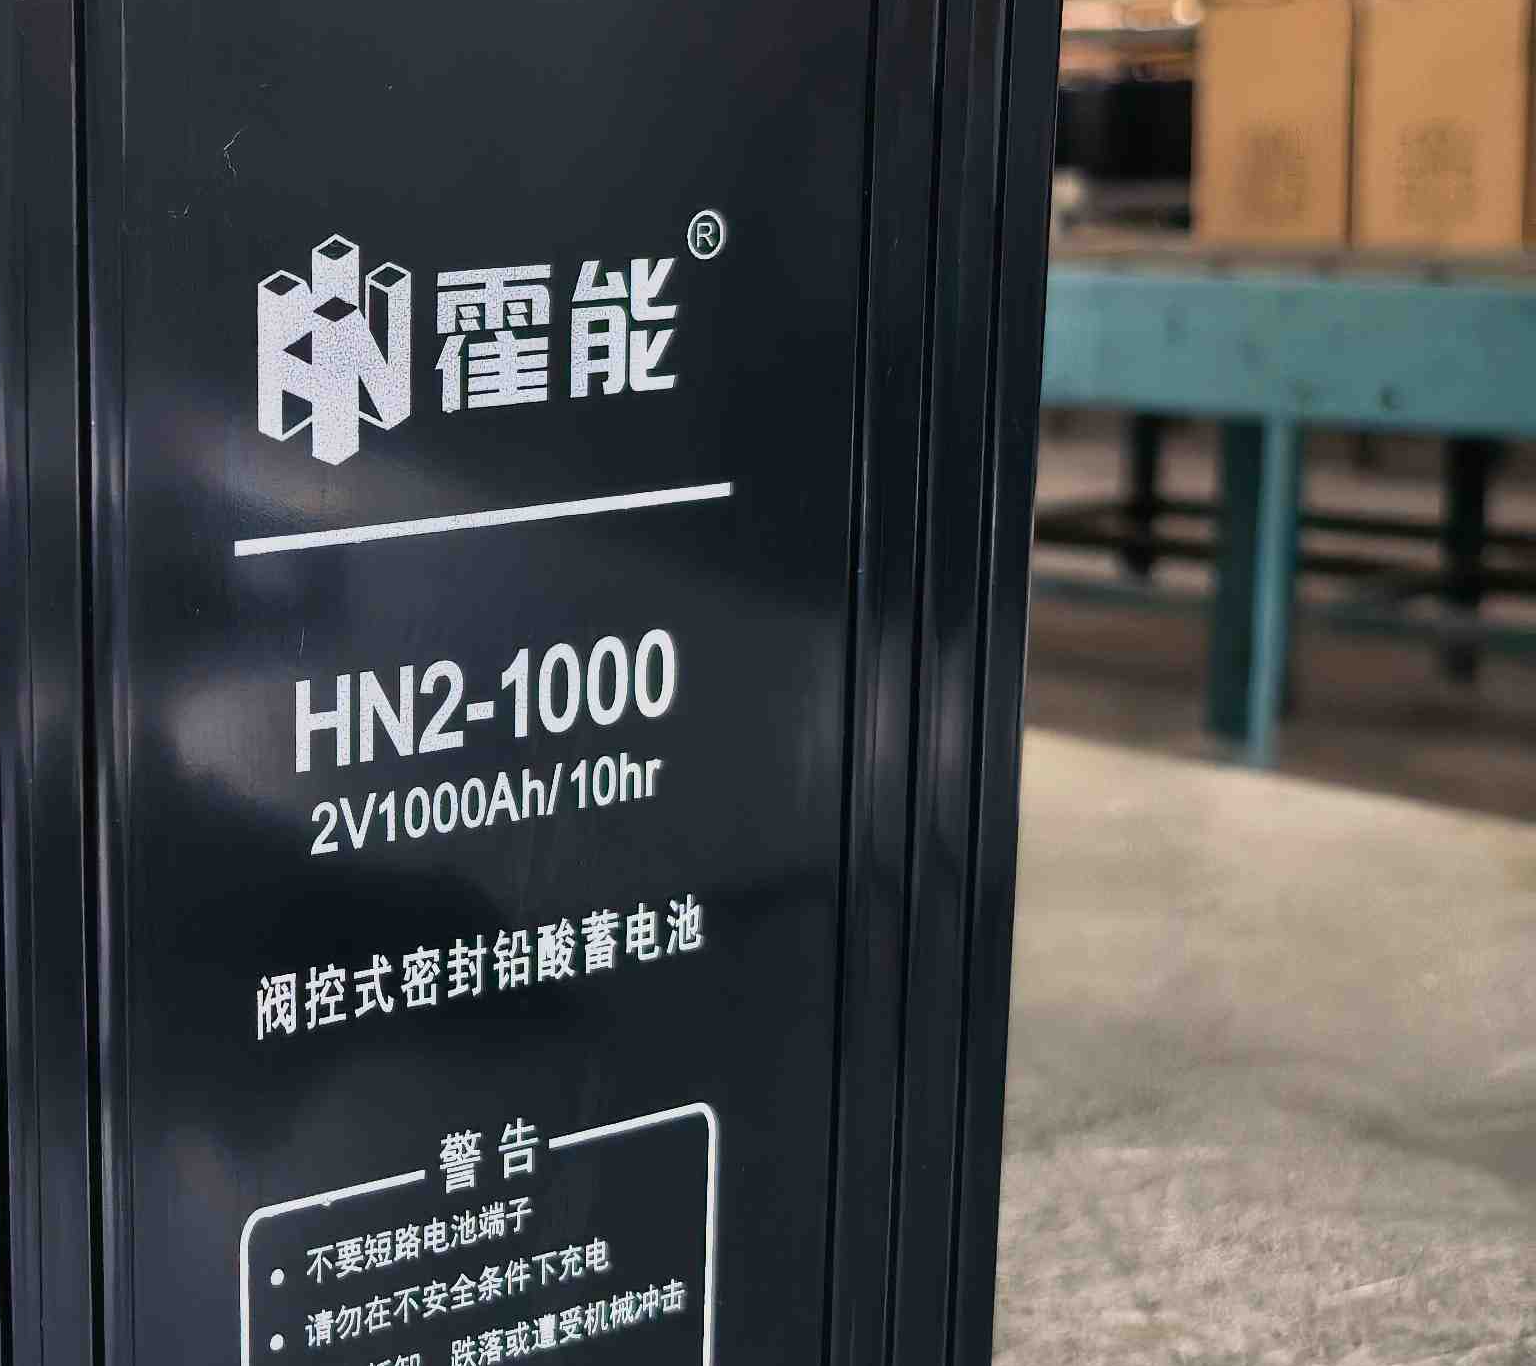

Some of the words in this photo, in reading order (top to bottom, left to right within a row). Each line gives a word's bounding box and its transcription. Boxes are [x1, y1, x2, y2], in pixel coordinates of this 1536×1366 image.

[436, 257, 678, 413] 霍能
[295, 629, 677, 773] HN2-1000
[311, 752, 662, 856] 2V1000Ah/10hr
[257, 893, 704, 1041] 阀控式密封铅酸蓄电池
[305, 1237, 610, 1348] 请勿在不安全条件下充电
[306, 1196, 533, 1284] 不要短路电池端子
